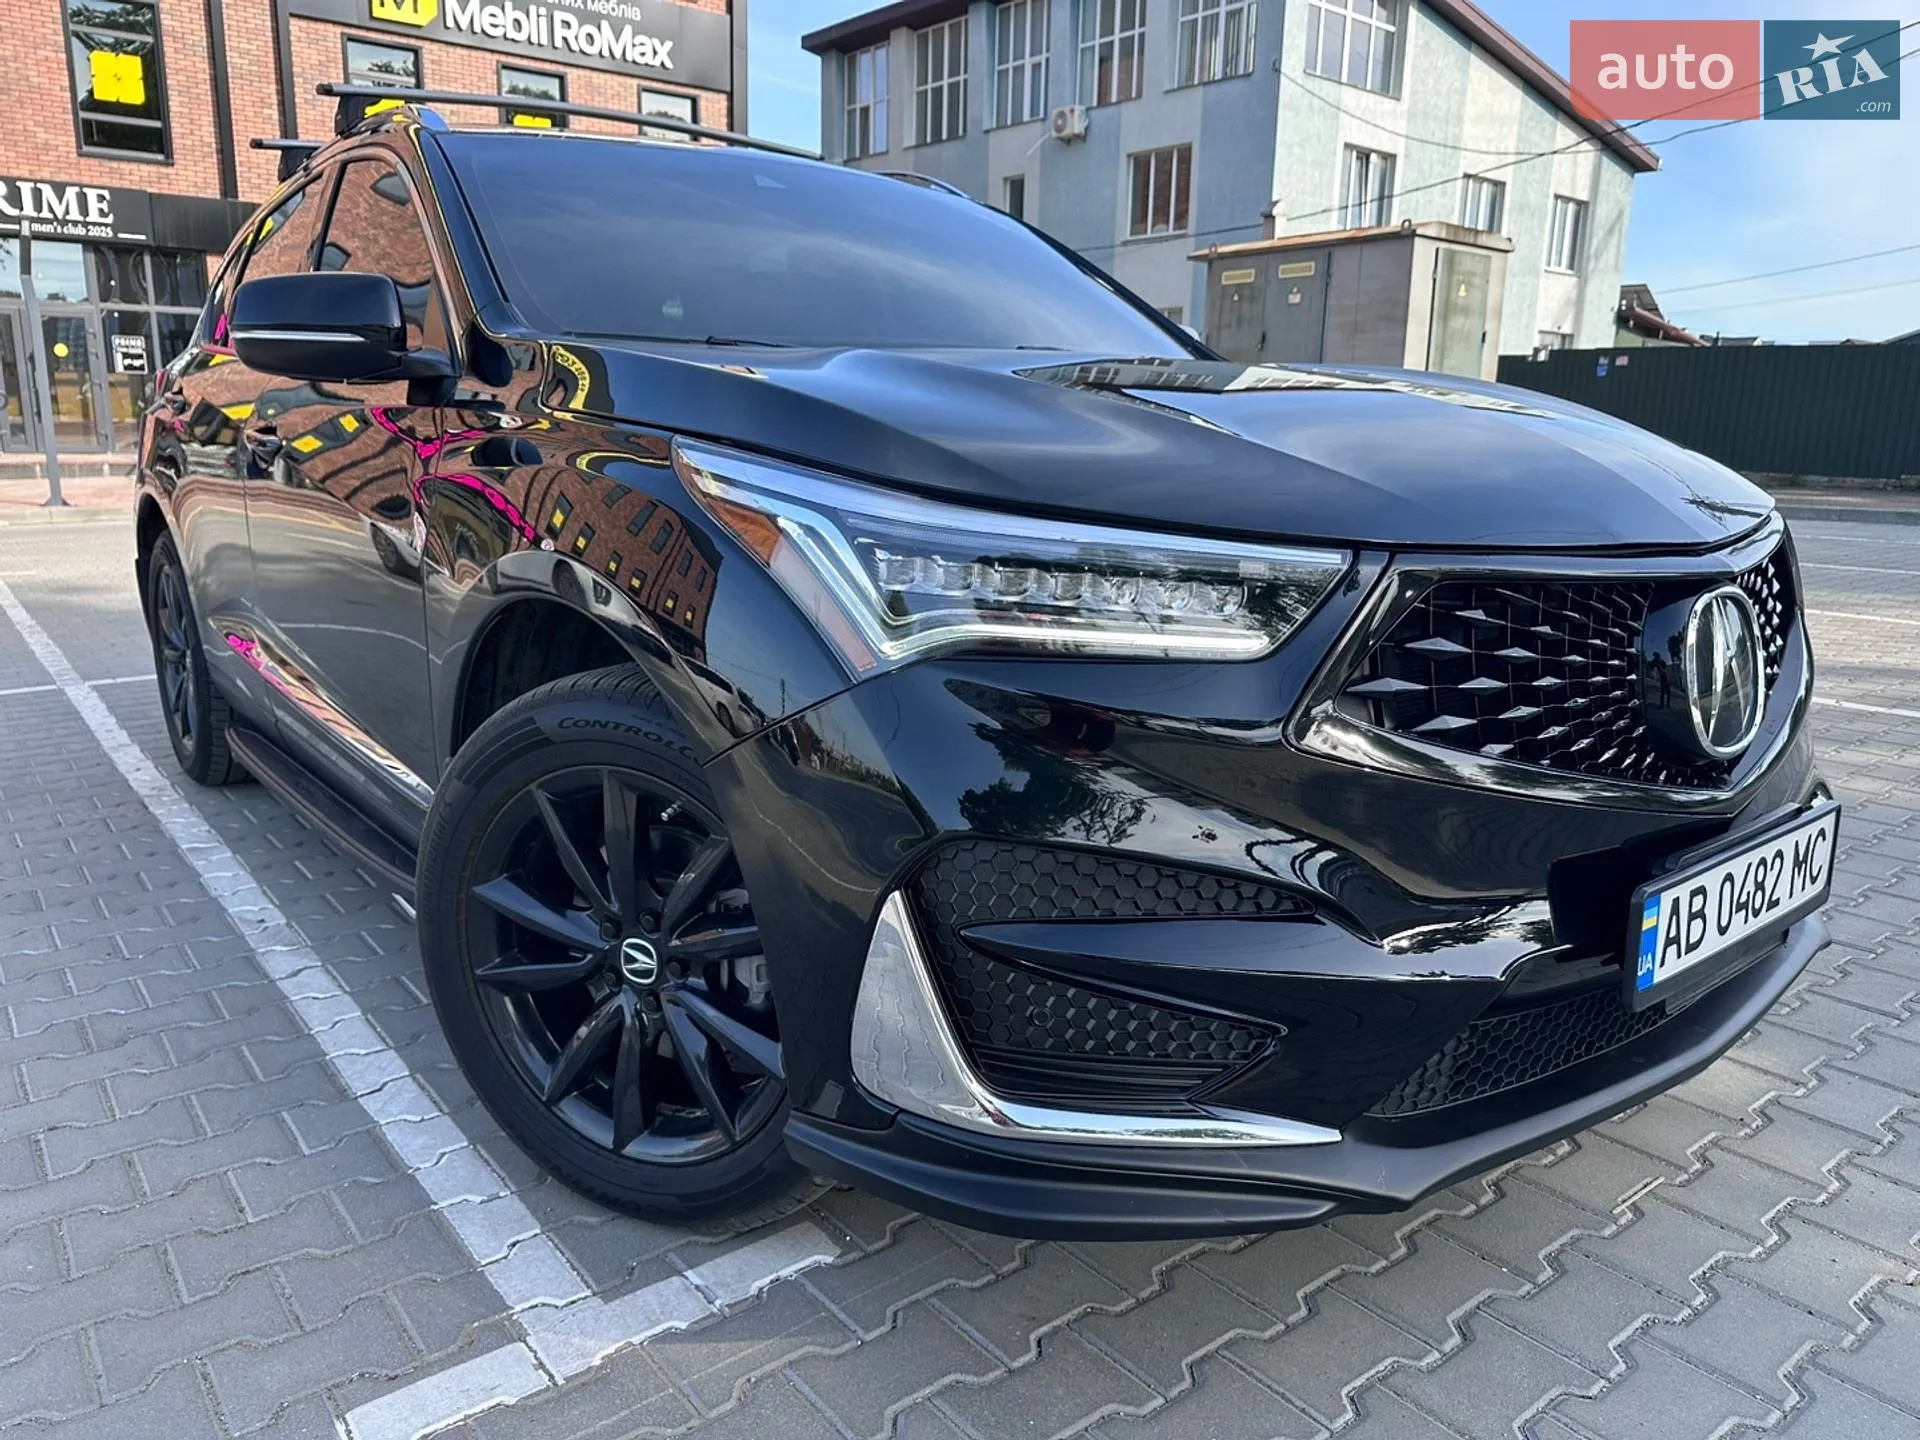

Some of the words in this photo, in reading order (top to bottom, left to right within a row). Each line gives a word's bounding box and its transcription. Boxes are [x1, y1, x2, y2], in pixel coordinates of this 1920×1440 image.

[444, 0, 549, 46] Mebli
[554, 10, 674, 69] RoMax
[30, 221, 62, 234] men's
[63, 222, 87, 236] club
[1659, 884, 1708, 968] AB
[1716, 848, 1785, 937] 0482
[1788, 826, 1827, 900] MC
[1637, 952, 1654, 977] UA
